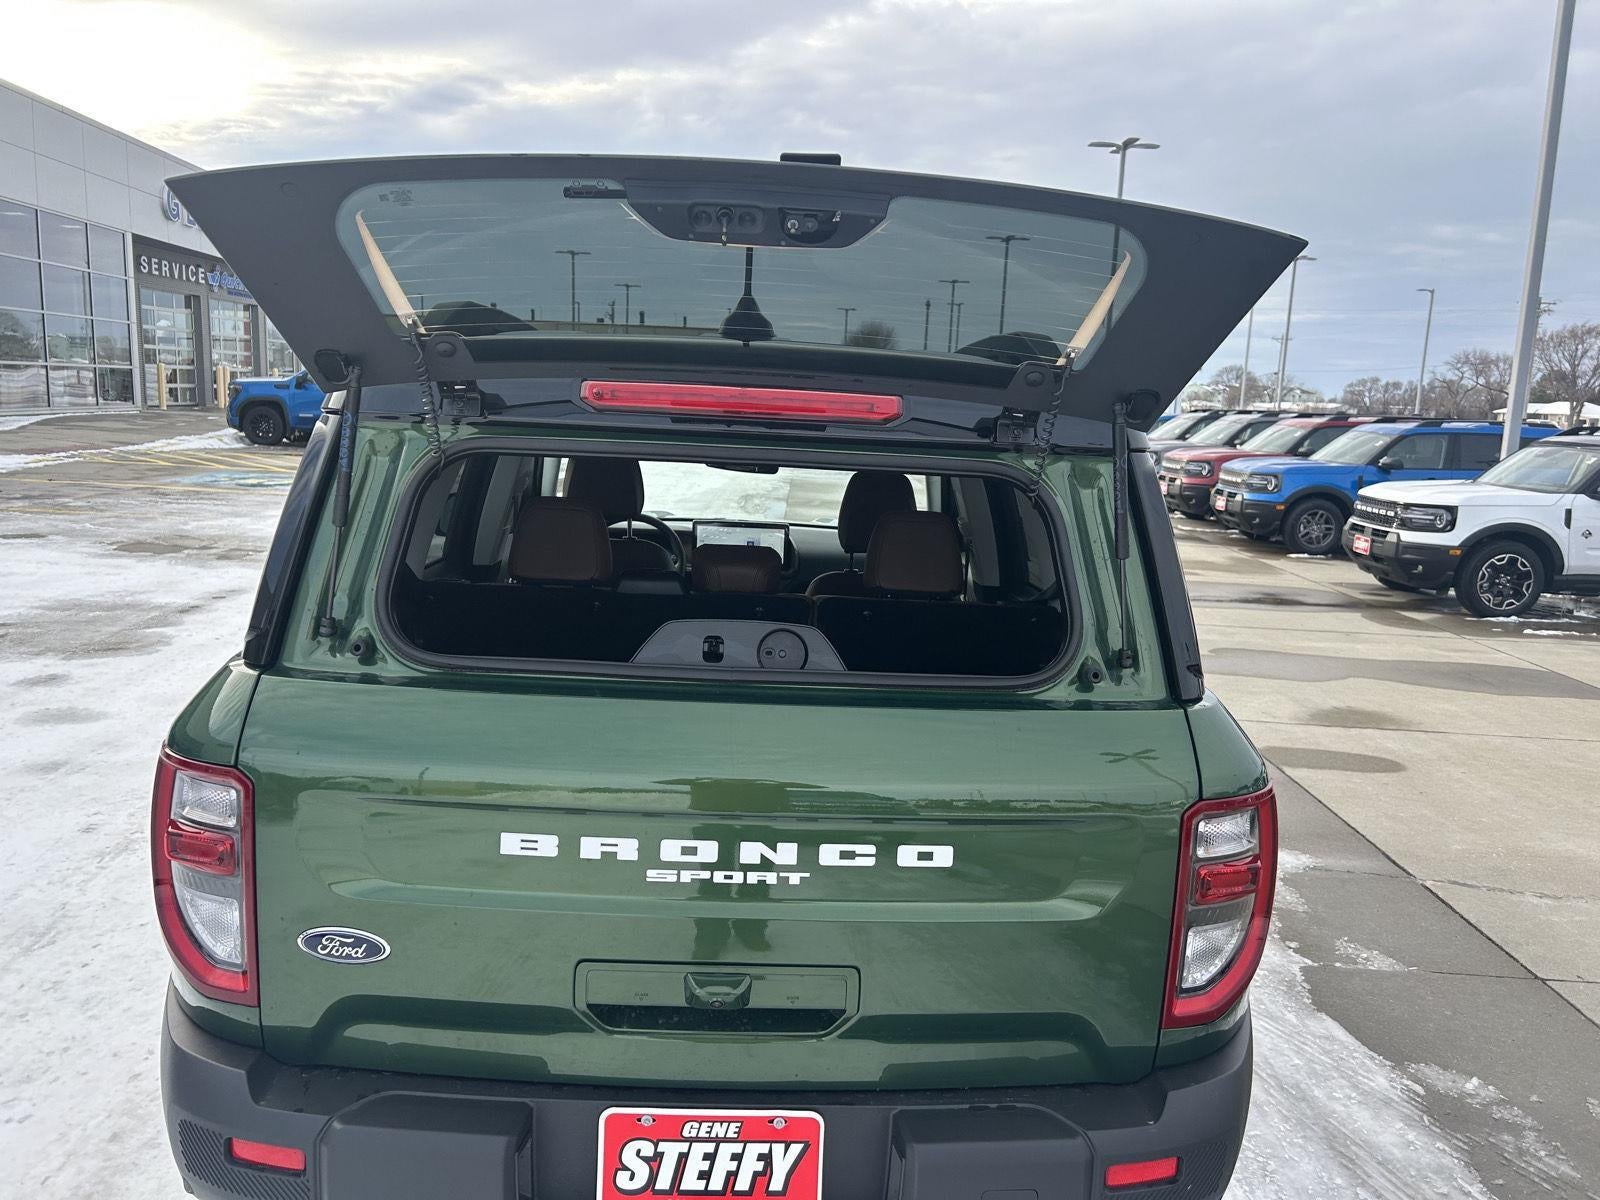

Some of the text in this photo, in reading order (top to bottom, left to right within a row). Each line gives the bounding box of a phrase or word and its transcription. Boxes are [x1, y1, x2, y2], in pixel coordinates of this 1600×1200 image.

[140, 255, 206, 284] SERVICE
[500, 832, 954, 868] BRONCO
[645, 869, 811, 885] SPORT
[317, 934, 367, 958] Ford
[681, 1120, 743, 1139] GENE
[614, 1138, 807, 1194] STEFFY
